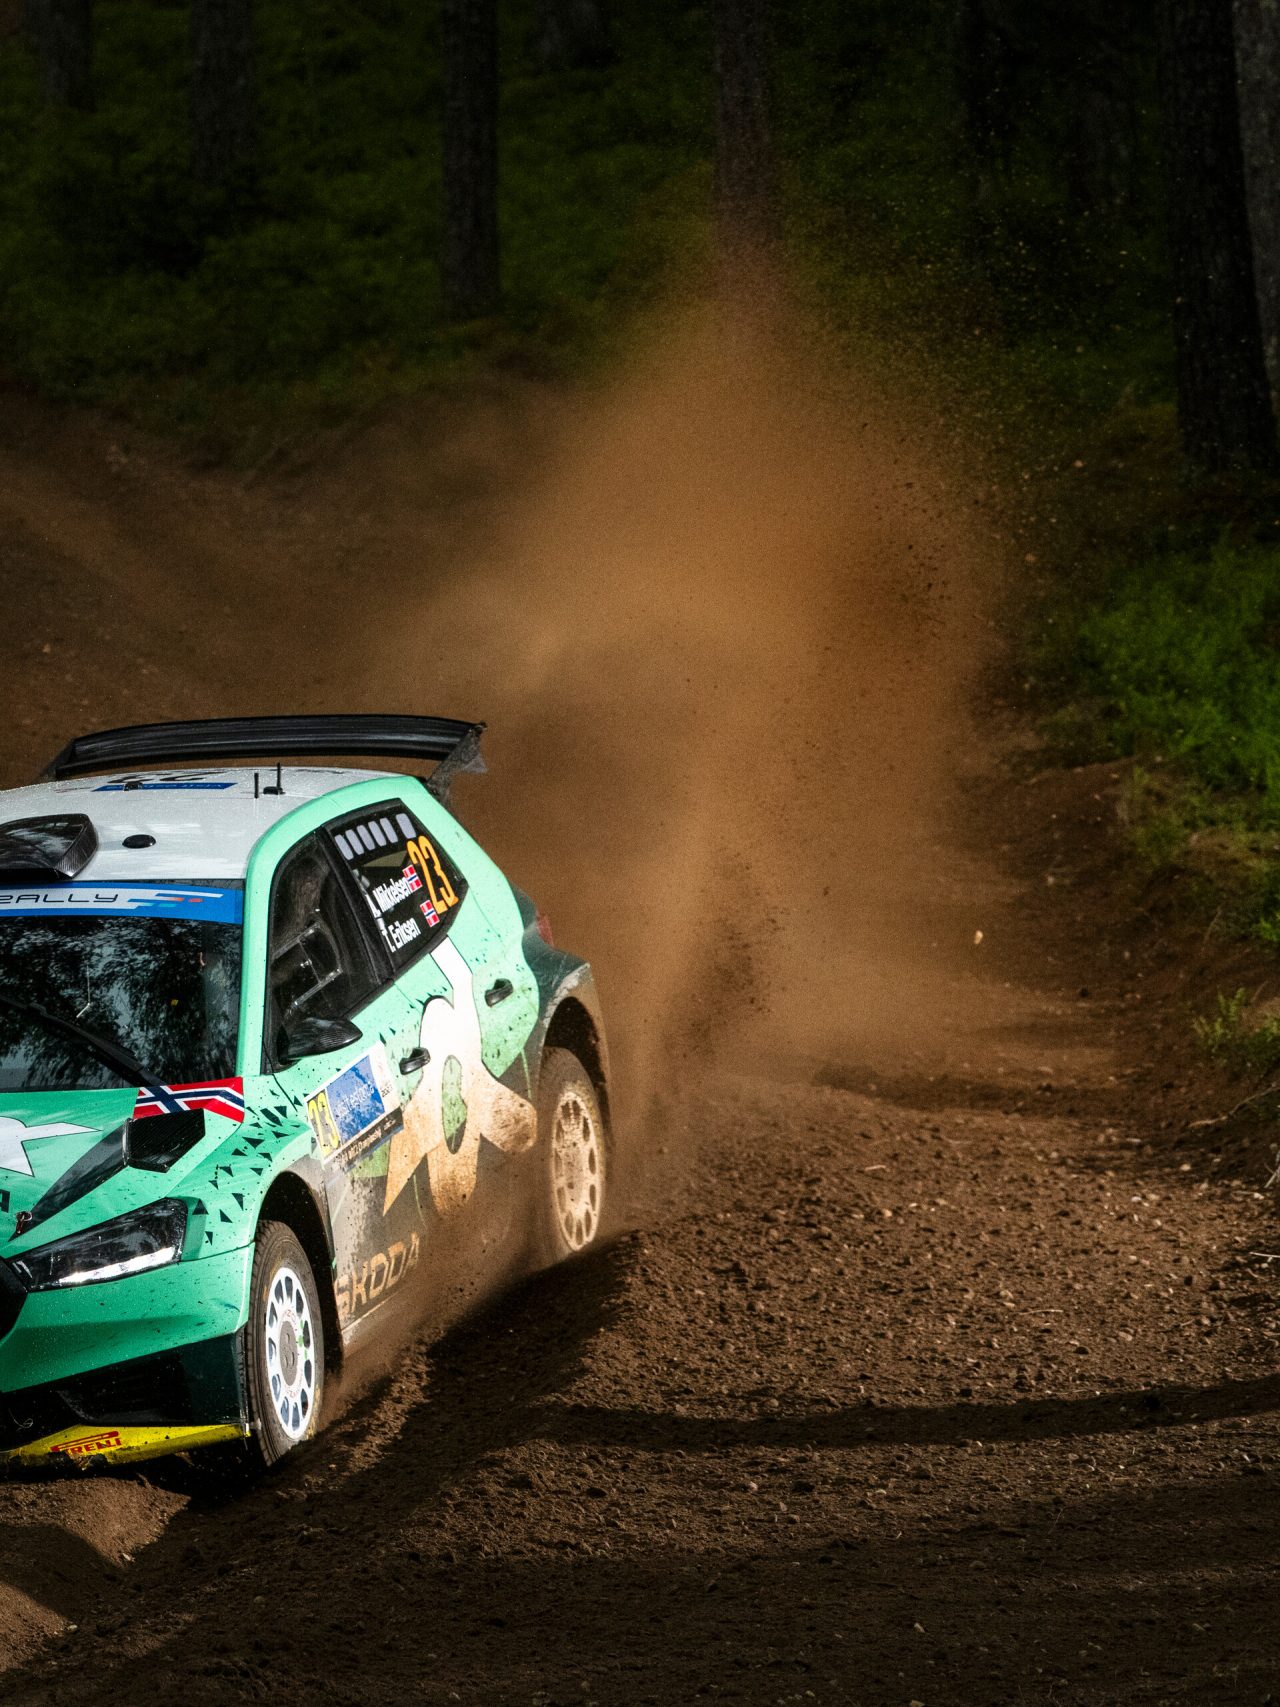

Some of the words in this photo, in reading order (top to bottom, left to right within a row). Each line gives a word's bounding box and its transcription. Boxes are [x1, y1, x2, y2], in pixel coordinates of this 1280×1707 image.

[372, 878, 413, 913] Mikkelsen
[406, 835, 459, 914] 23
[387, 917, 421, 949] Eriksen
[307, 1091, 340, 1159] 23
